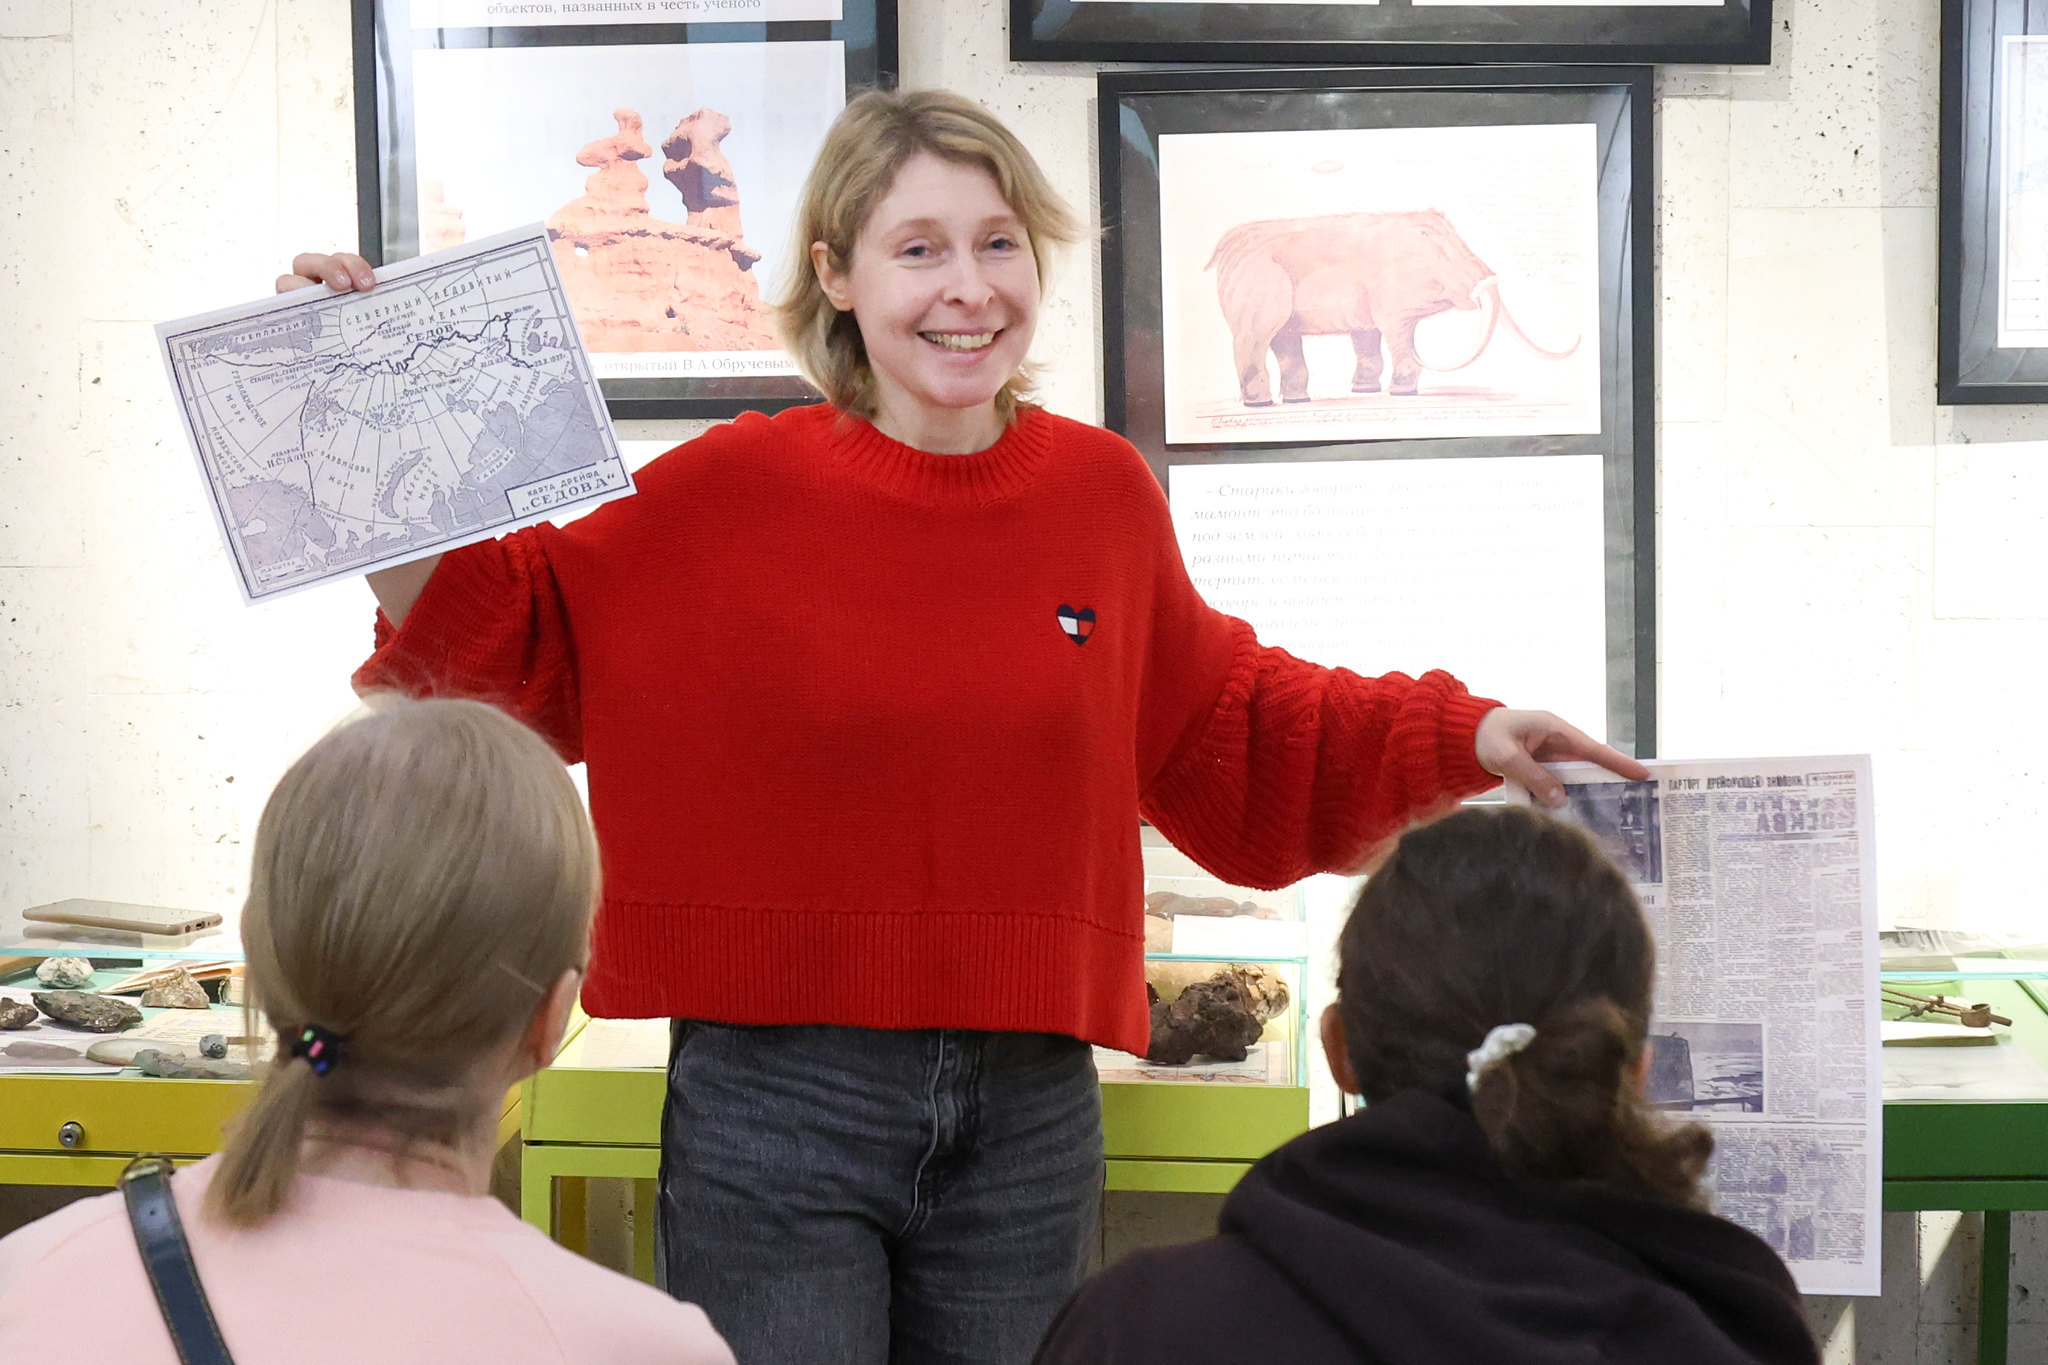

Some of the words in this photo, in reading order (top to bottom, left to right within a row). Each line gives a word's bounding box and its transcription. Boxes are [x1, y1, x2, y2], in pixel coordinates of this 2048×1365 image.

[487, 2, 556, 15] объектов,
[562, 2, 643, 13] названных
[647, 2, 656, 11] в
[660, 1, 700, 11] честь
[346, 296, 422, 326] СЕВЕРНЫЙ
[434, 268, 512, 301] ЛЕДОВИТЫЙ
[418, 305, 468, 326] ОКЕАН
[234, 320, 307, 344] ГРЕНЛАНДИЯ
[604, 359, 678, 373] открытый
[226, 394, 246, 424] МОРЕ
[328, 475, 355, 490] МОРЕ
[527, 483, 556, 497] КАРТА
[560, 469, 600, 488] ДРЕЙФА
[1219, 483, 1295, 500] Старики
[1190, 509, 1261, 520] мамонт
[1192, 529, 1221, 543] под
[1192, 554, 1266, 568] разными
[1193, 575, 1265, 590] терпит,
